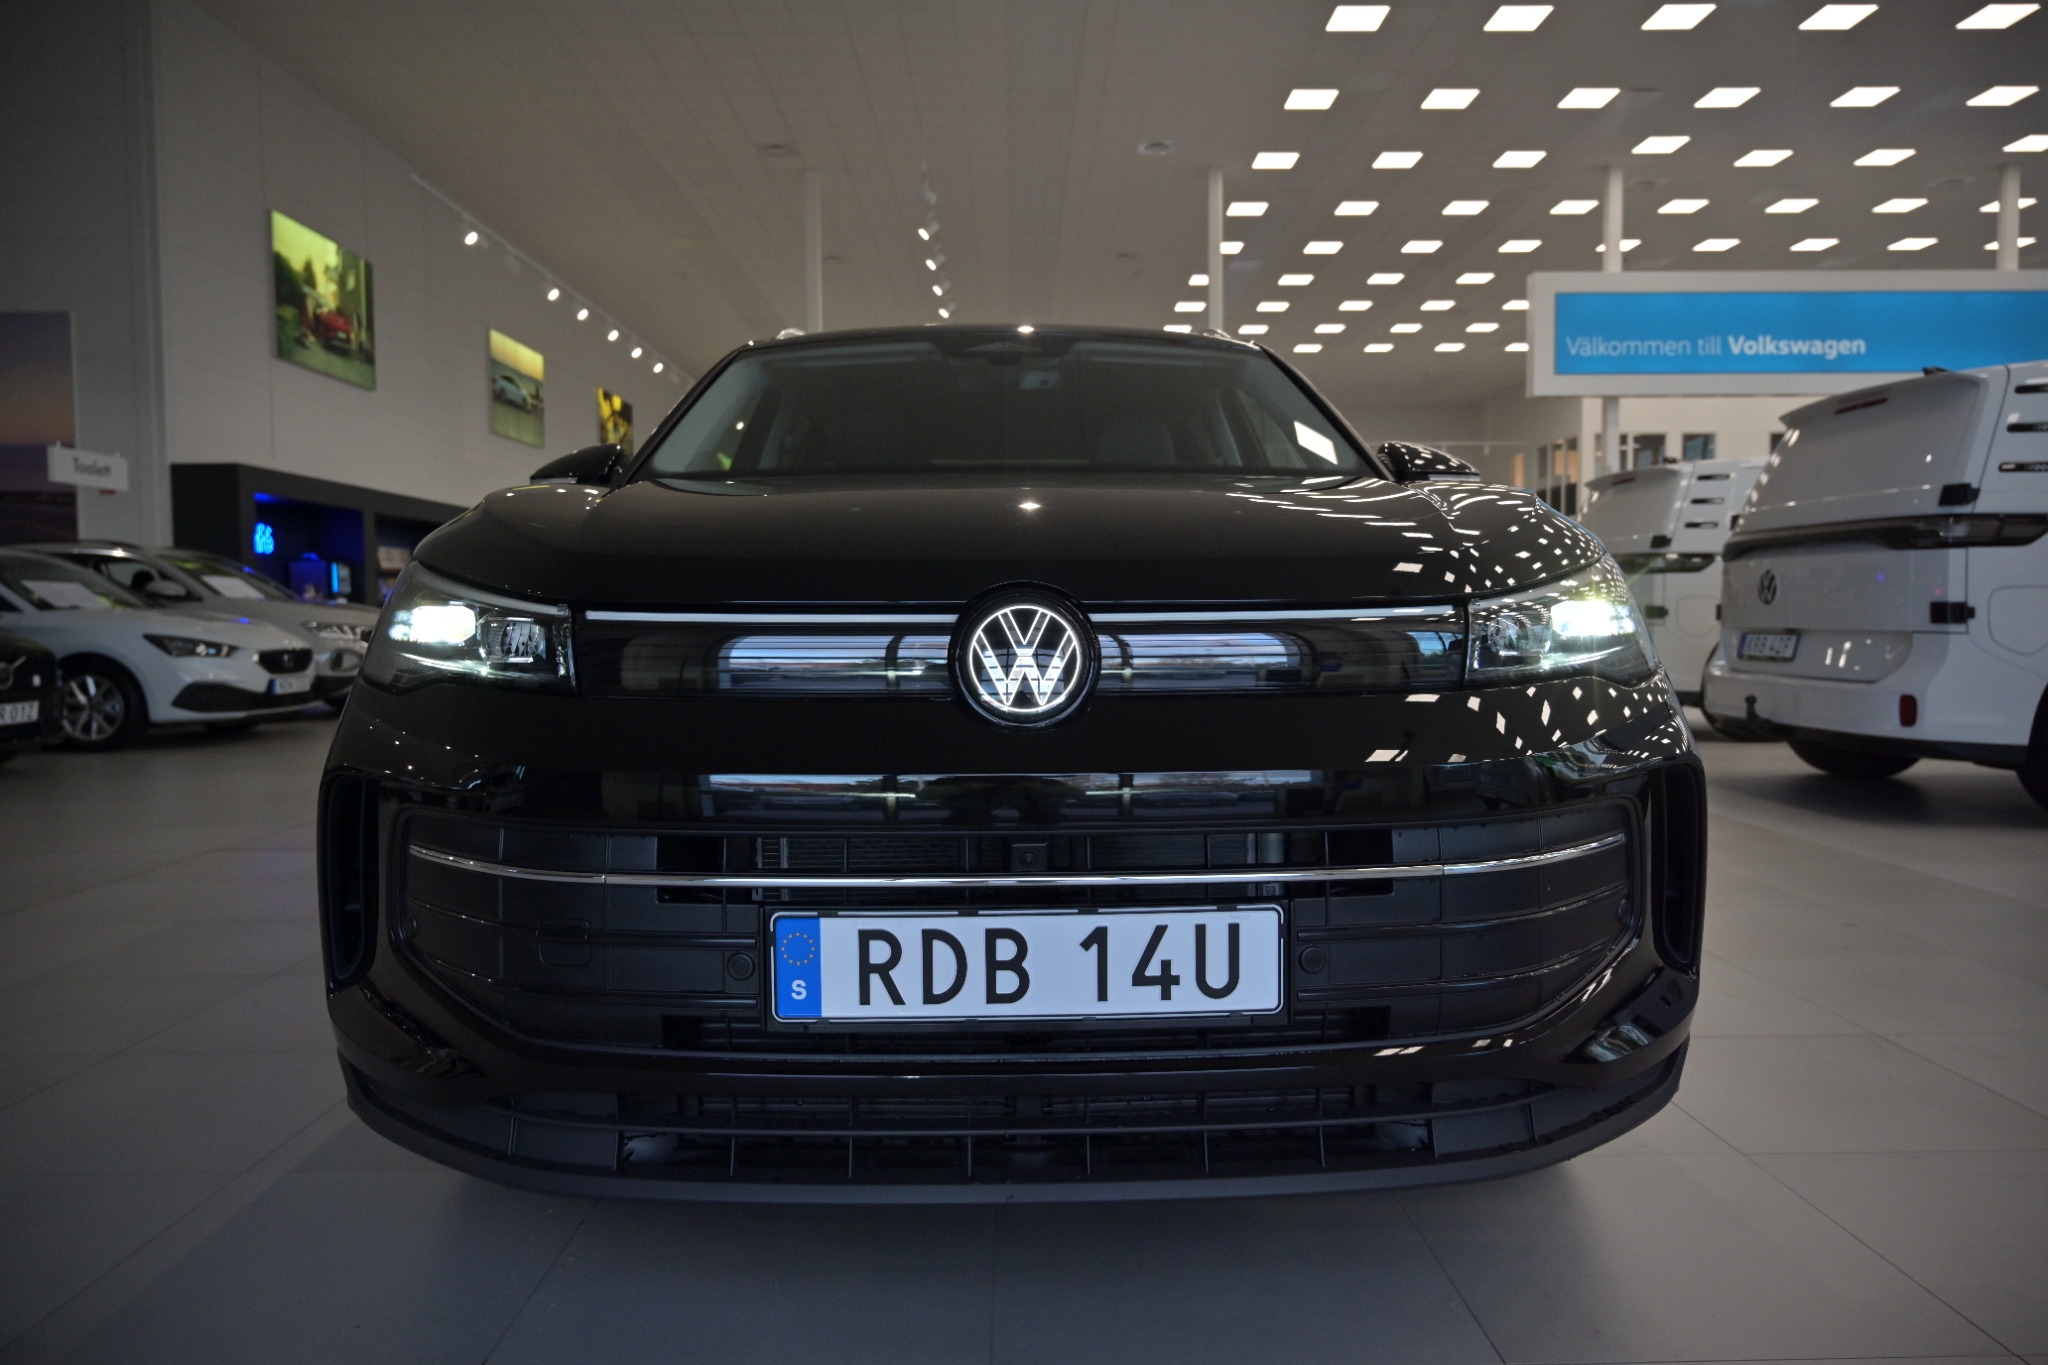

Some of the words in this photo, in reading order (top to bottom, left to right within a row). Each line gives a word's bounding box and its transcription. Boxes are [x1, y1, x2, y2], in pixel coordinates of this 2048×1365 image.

[1566, 337, 1691, 357] Välkommen
[1697, 336, 1722, 356] till
[1727, 336, 1867, 360] Volkswagen
[858, 928, 1031, 1006] RDB
[1079, 923, 1240, 1002] 14U
[791, 979, 808, 1001] S
